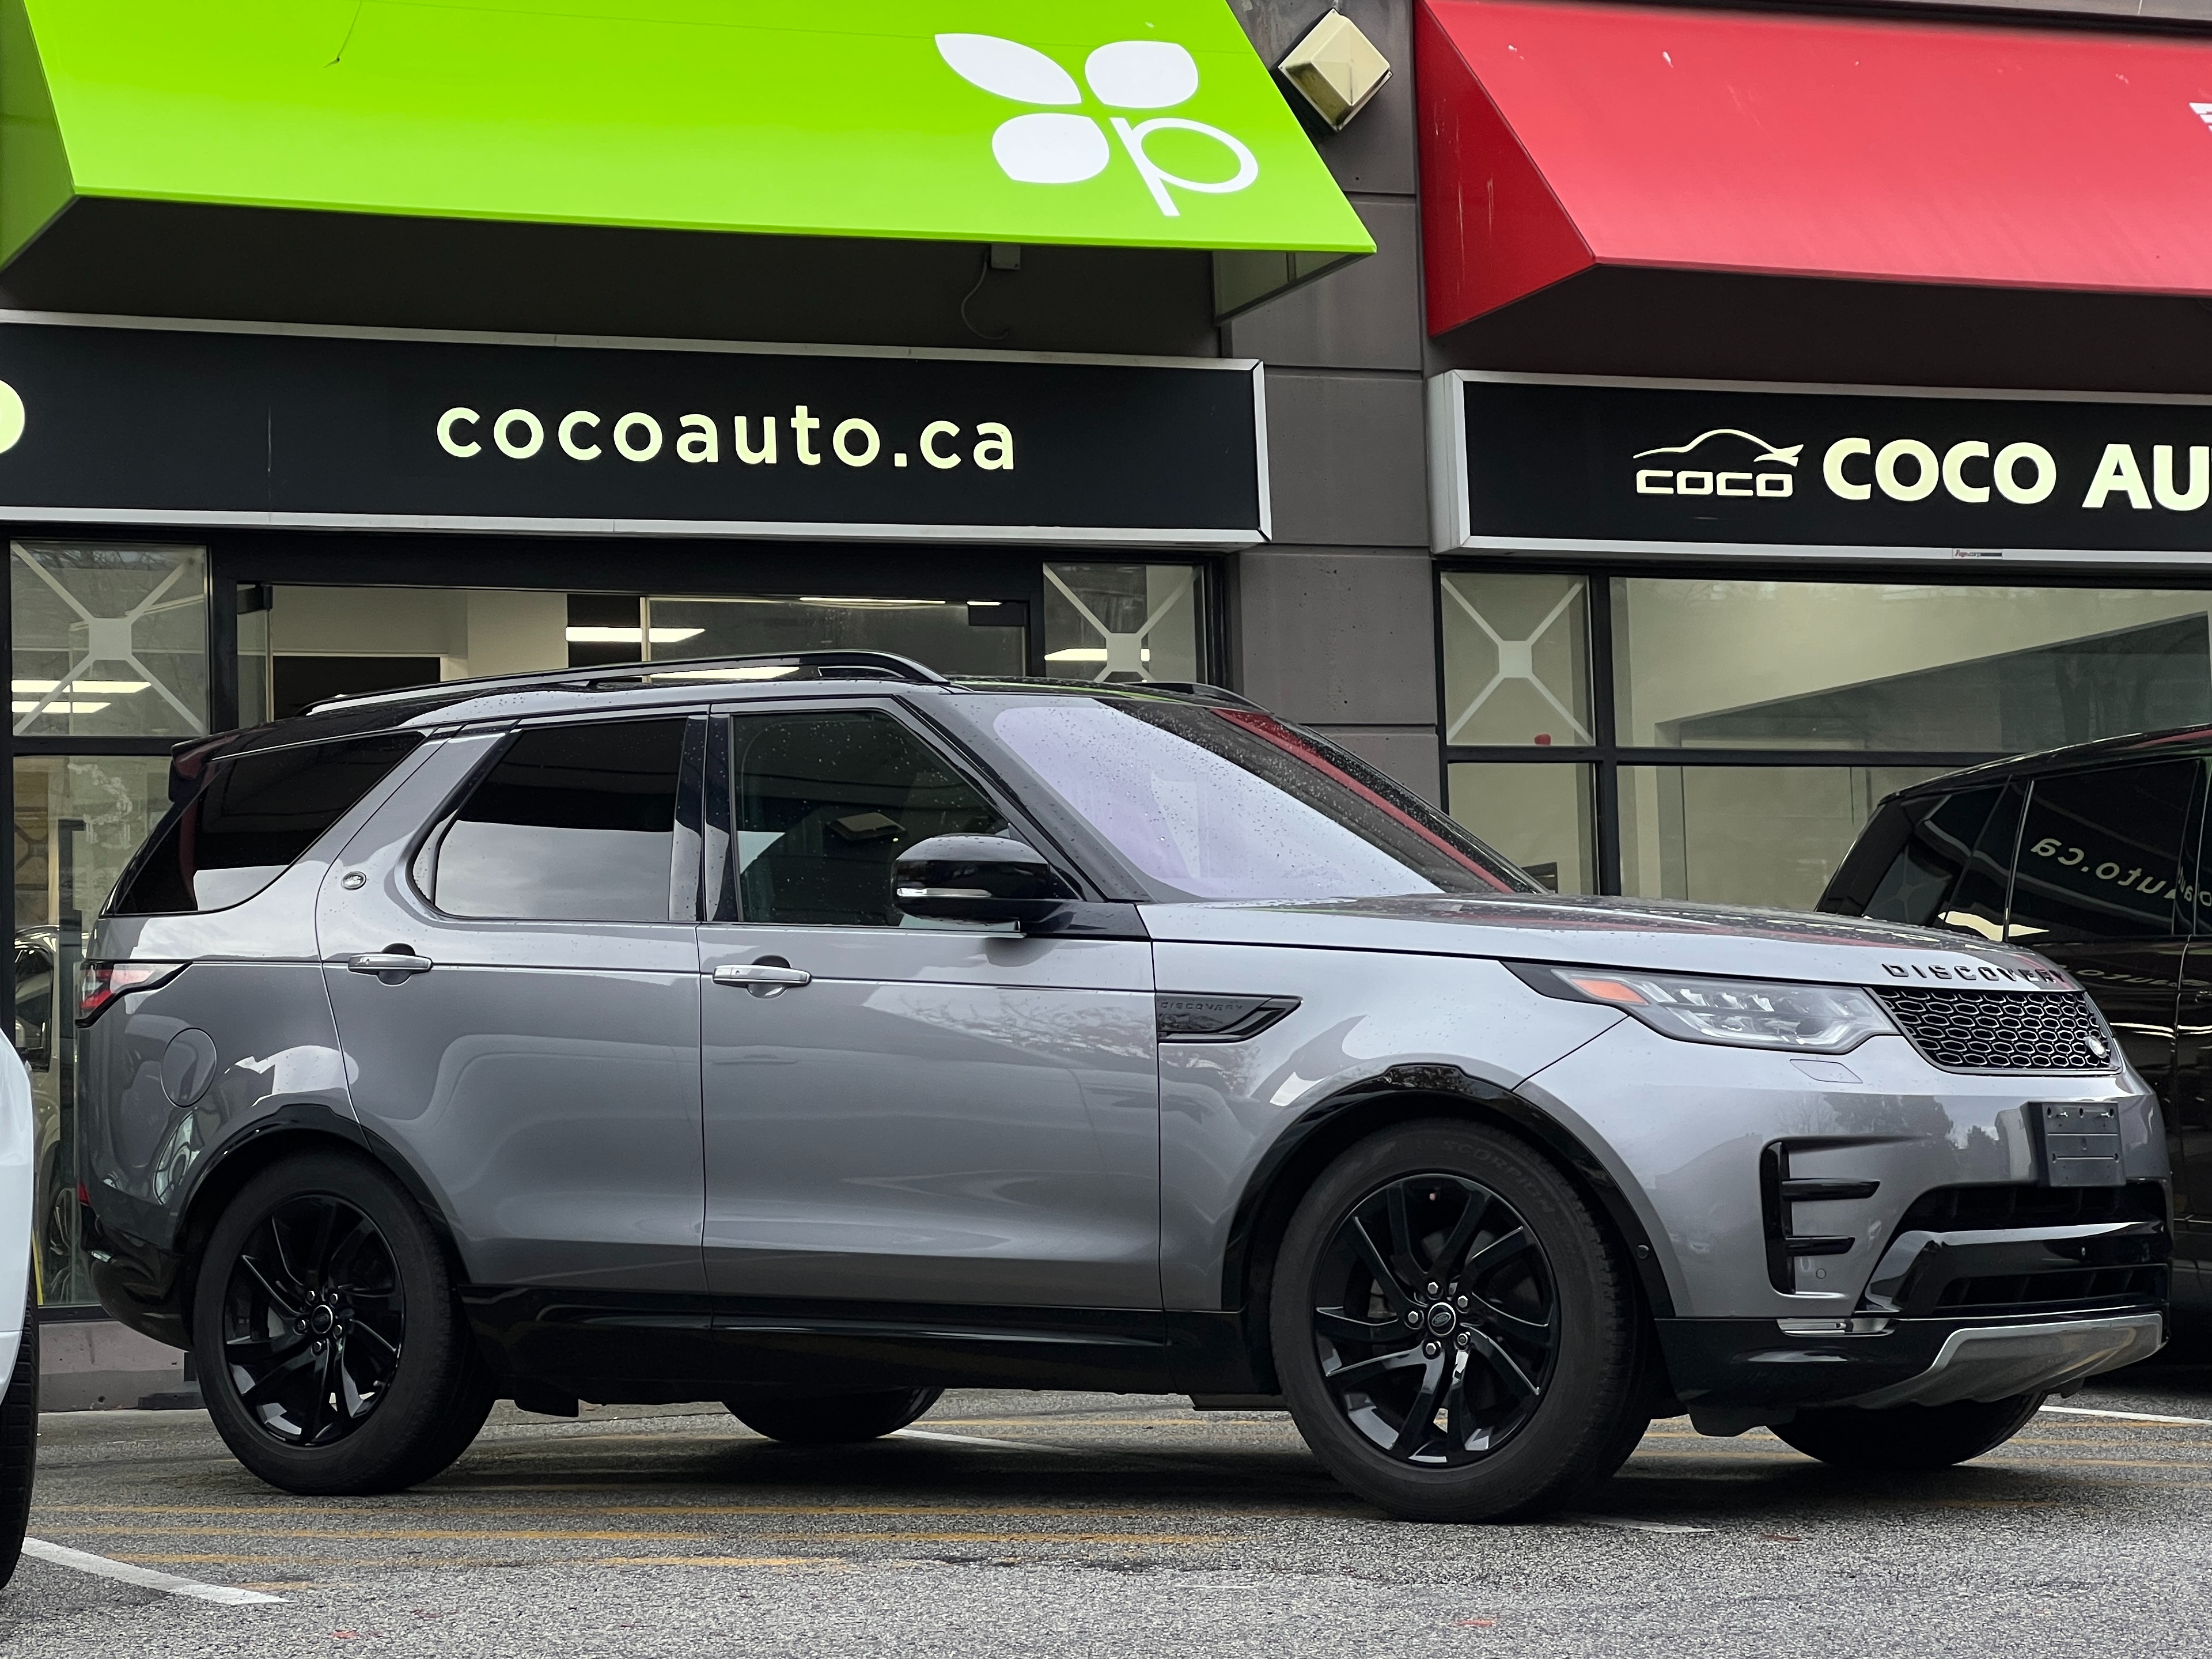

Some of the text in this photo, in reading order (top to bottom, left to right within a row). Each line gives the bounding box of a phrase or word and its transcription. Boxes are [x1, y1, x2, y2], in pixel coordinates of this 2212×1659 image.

[437, 405, 1014, 470] cocoauto.ca
[1636, 469, 1794, 497] COCO
[1823, 437, 2212, 512] COCO AU
[1881, 963, 2066, 984] DISCOVERY
[1160, 1001, 1244, 1011] DISCOVERY
[1441, 1139, 1555, 1213] SCORPION
